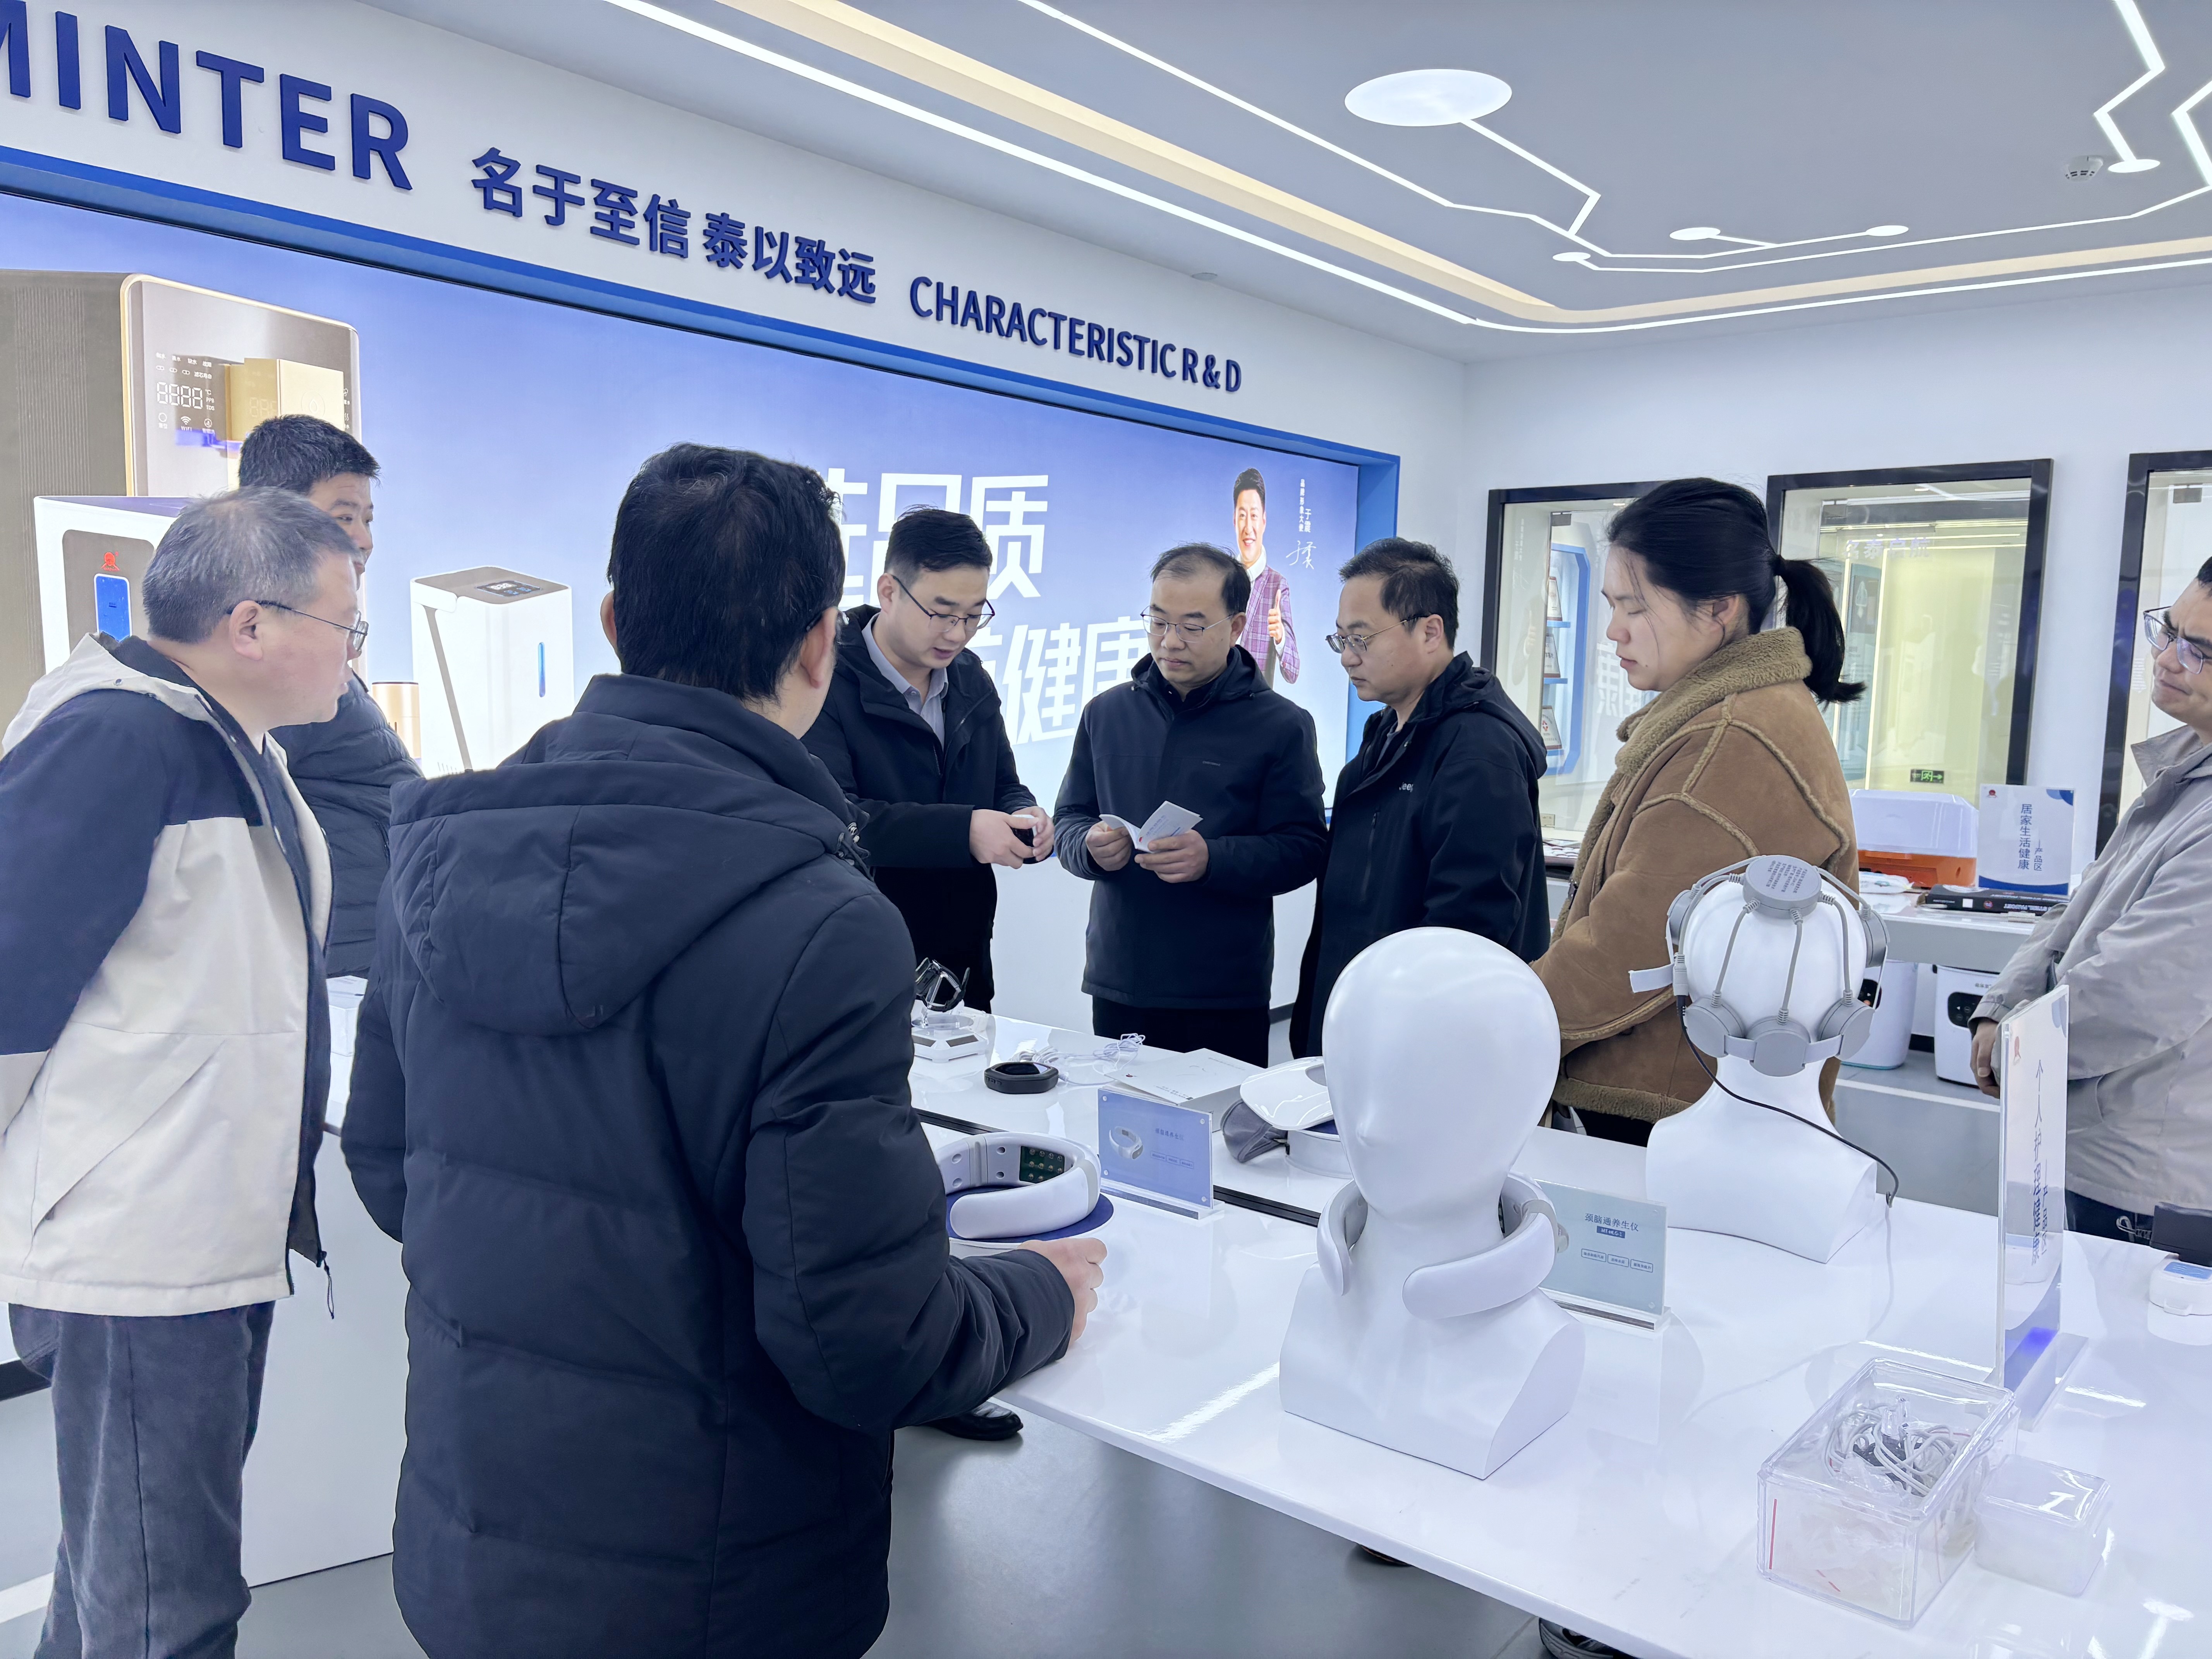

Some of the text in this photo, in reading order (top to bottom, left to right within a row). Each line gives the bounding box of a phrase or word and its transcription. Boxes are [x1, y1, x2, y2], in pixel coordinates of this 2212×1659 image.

[910, 276, 1176, 378] CHARACTERISTIC
[2018, 804, 2032, 870] 居家生活健康
[2032, 1060, 2044, 1266] 个人护理健康
